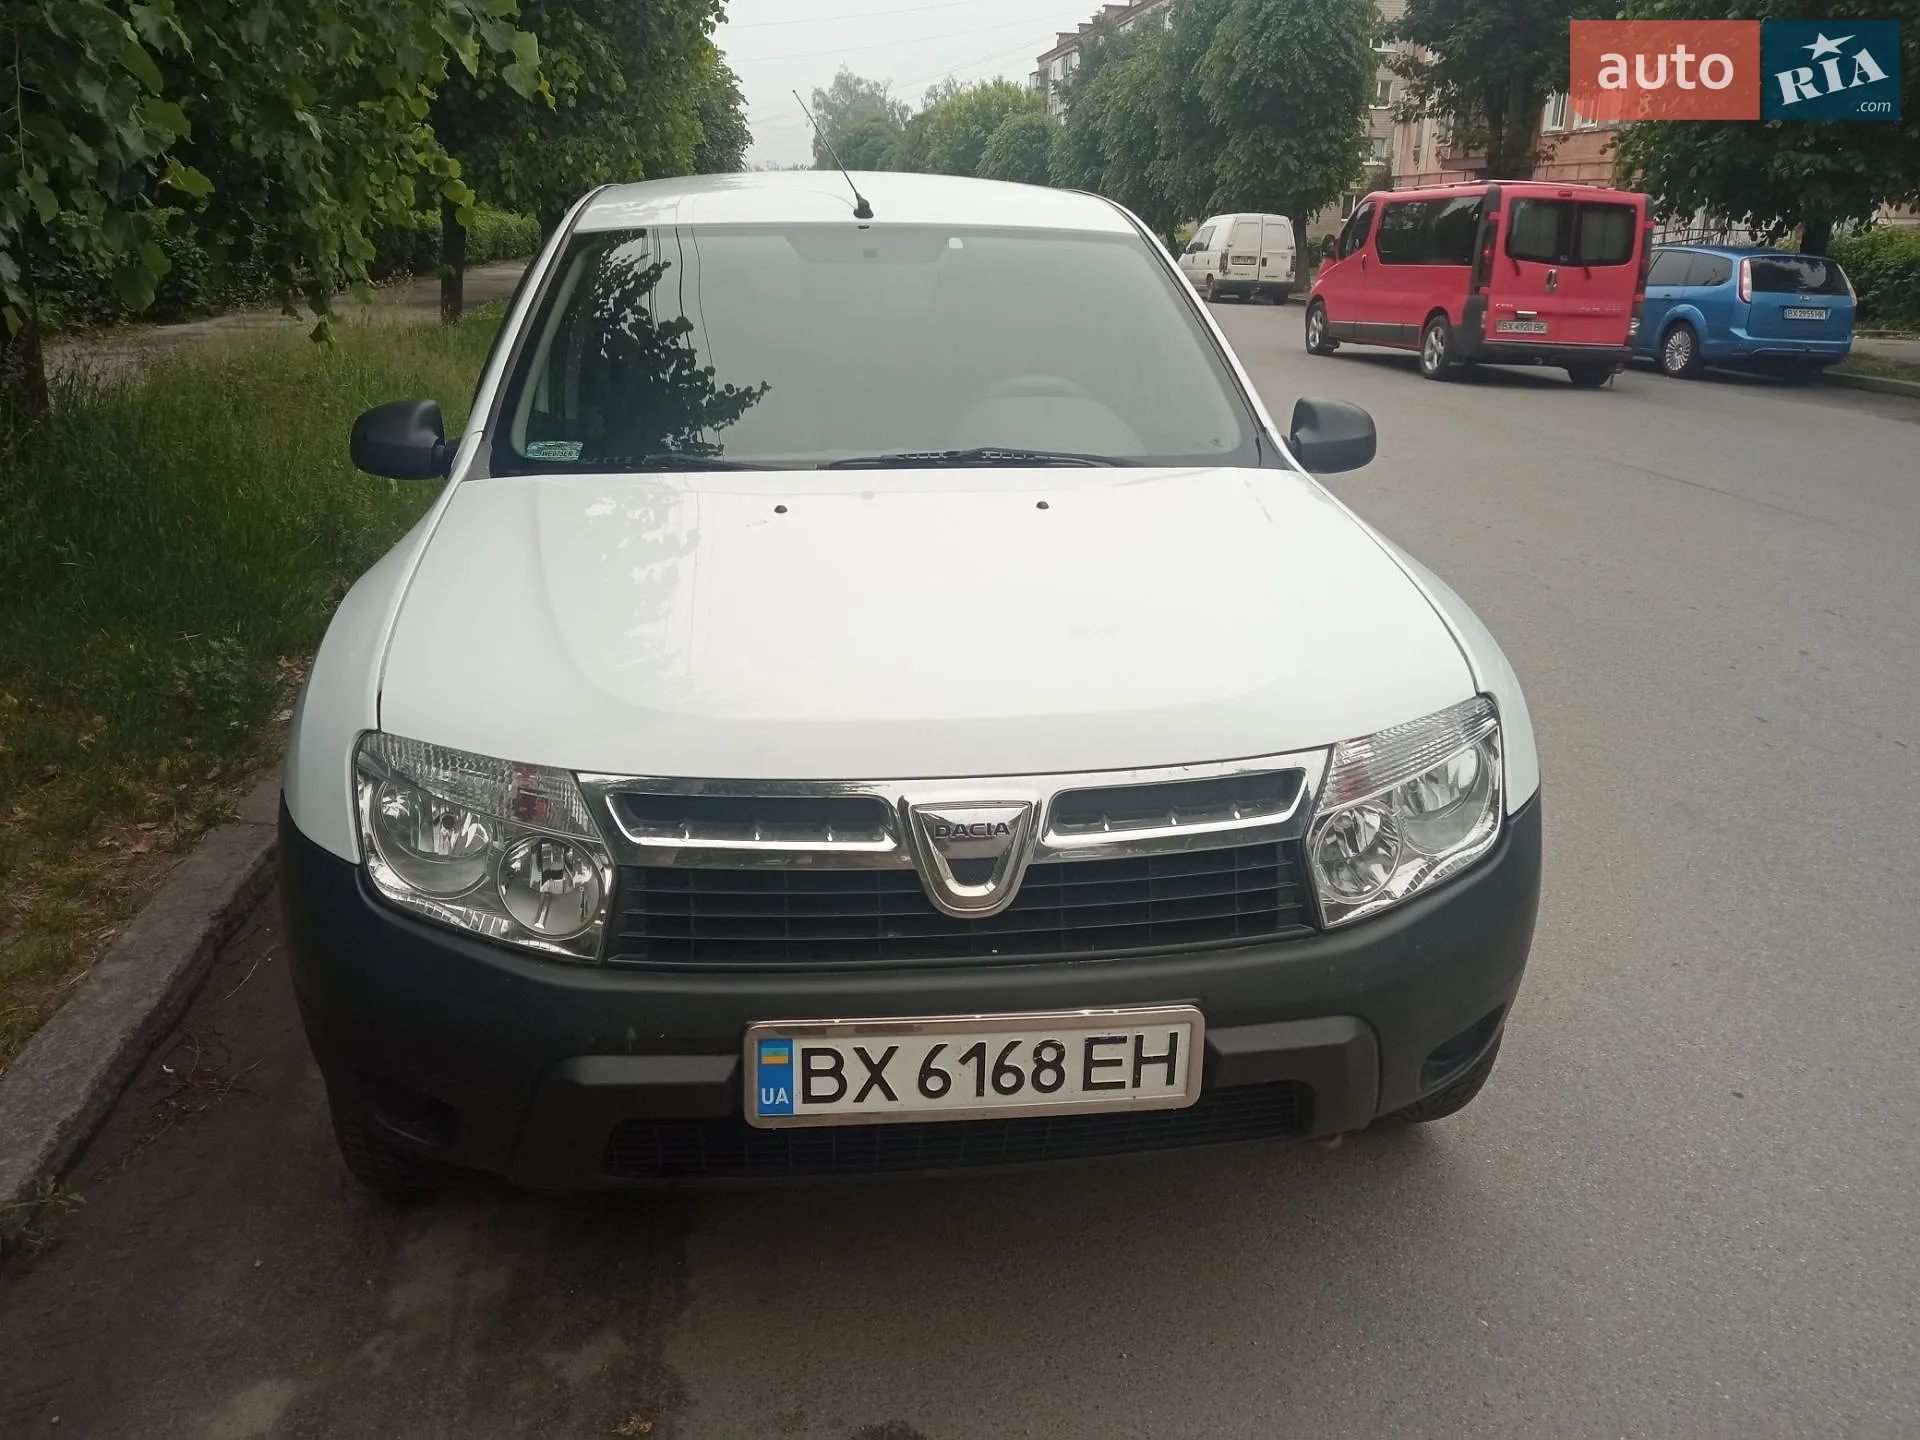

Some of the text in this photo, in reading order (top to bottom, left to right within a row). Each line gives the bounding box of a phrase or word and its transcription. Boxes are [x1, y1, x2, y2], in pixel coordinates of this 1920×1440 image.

[935, 822, 1010, 838] DACIA
[801, 1031, 1179, 1104] BX 6168 EH
[761, 1087, 790, 1105] UA
